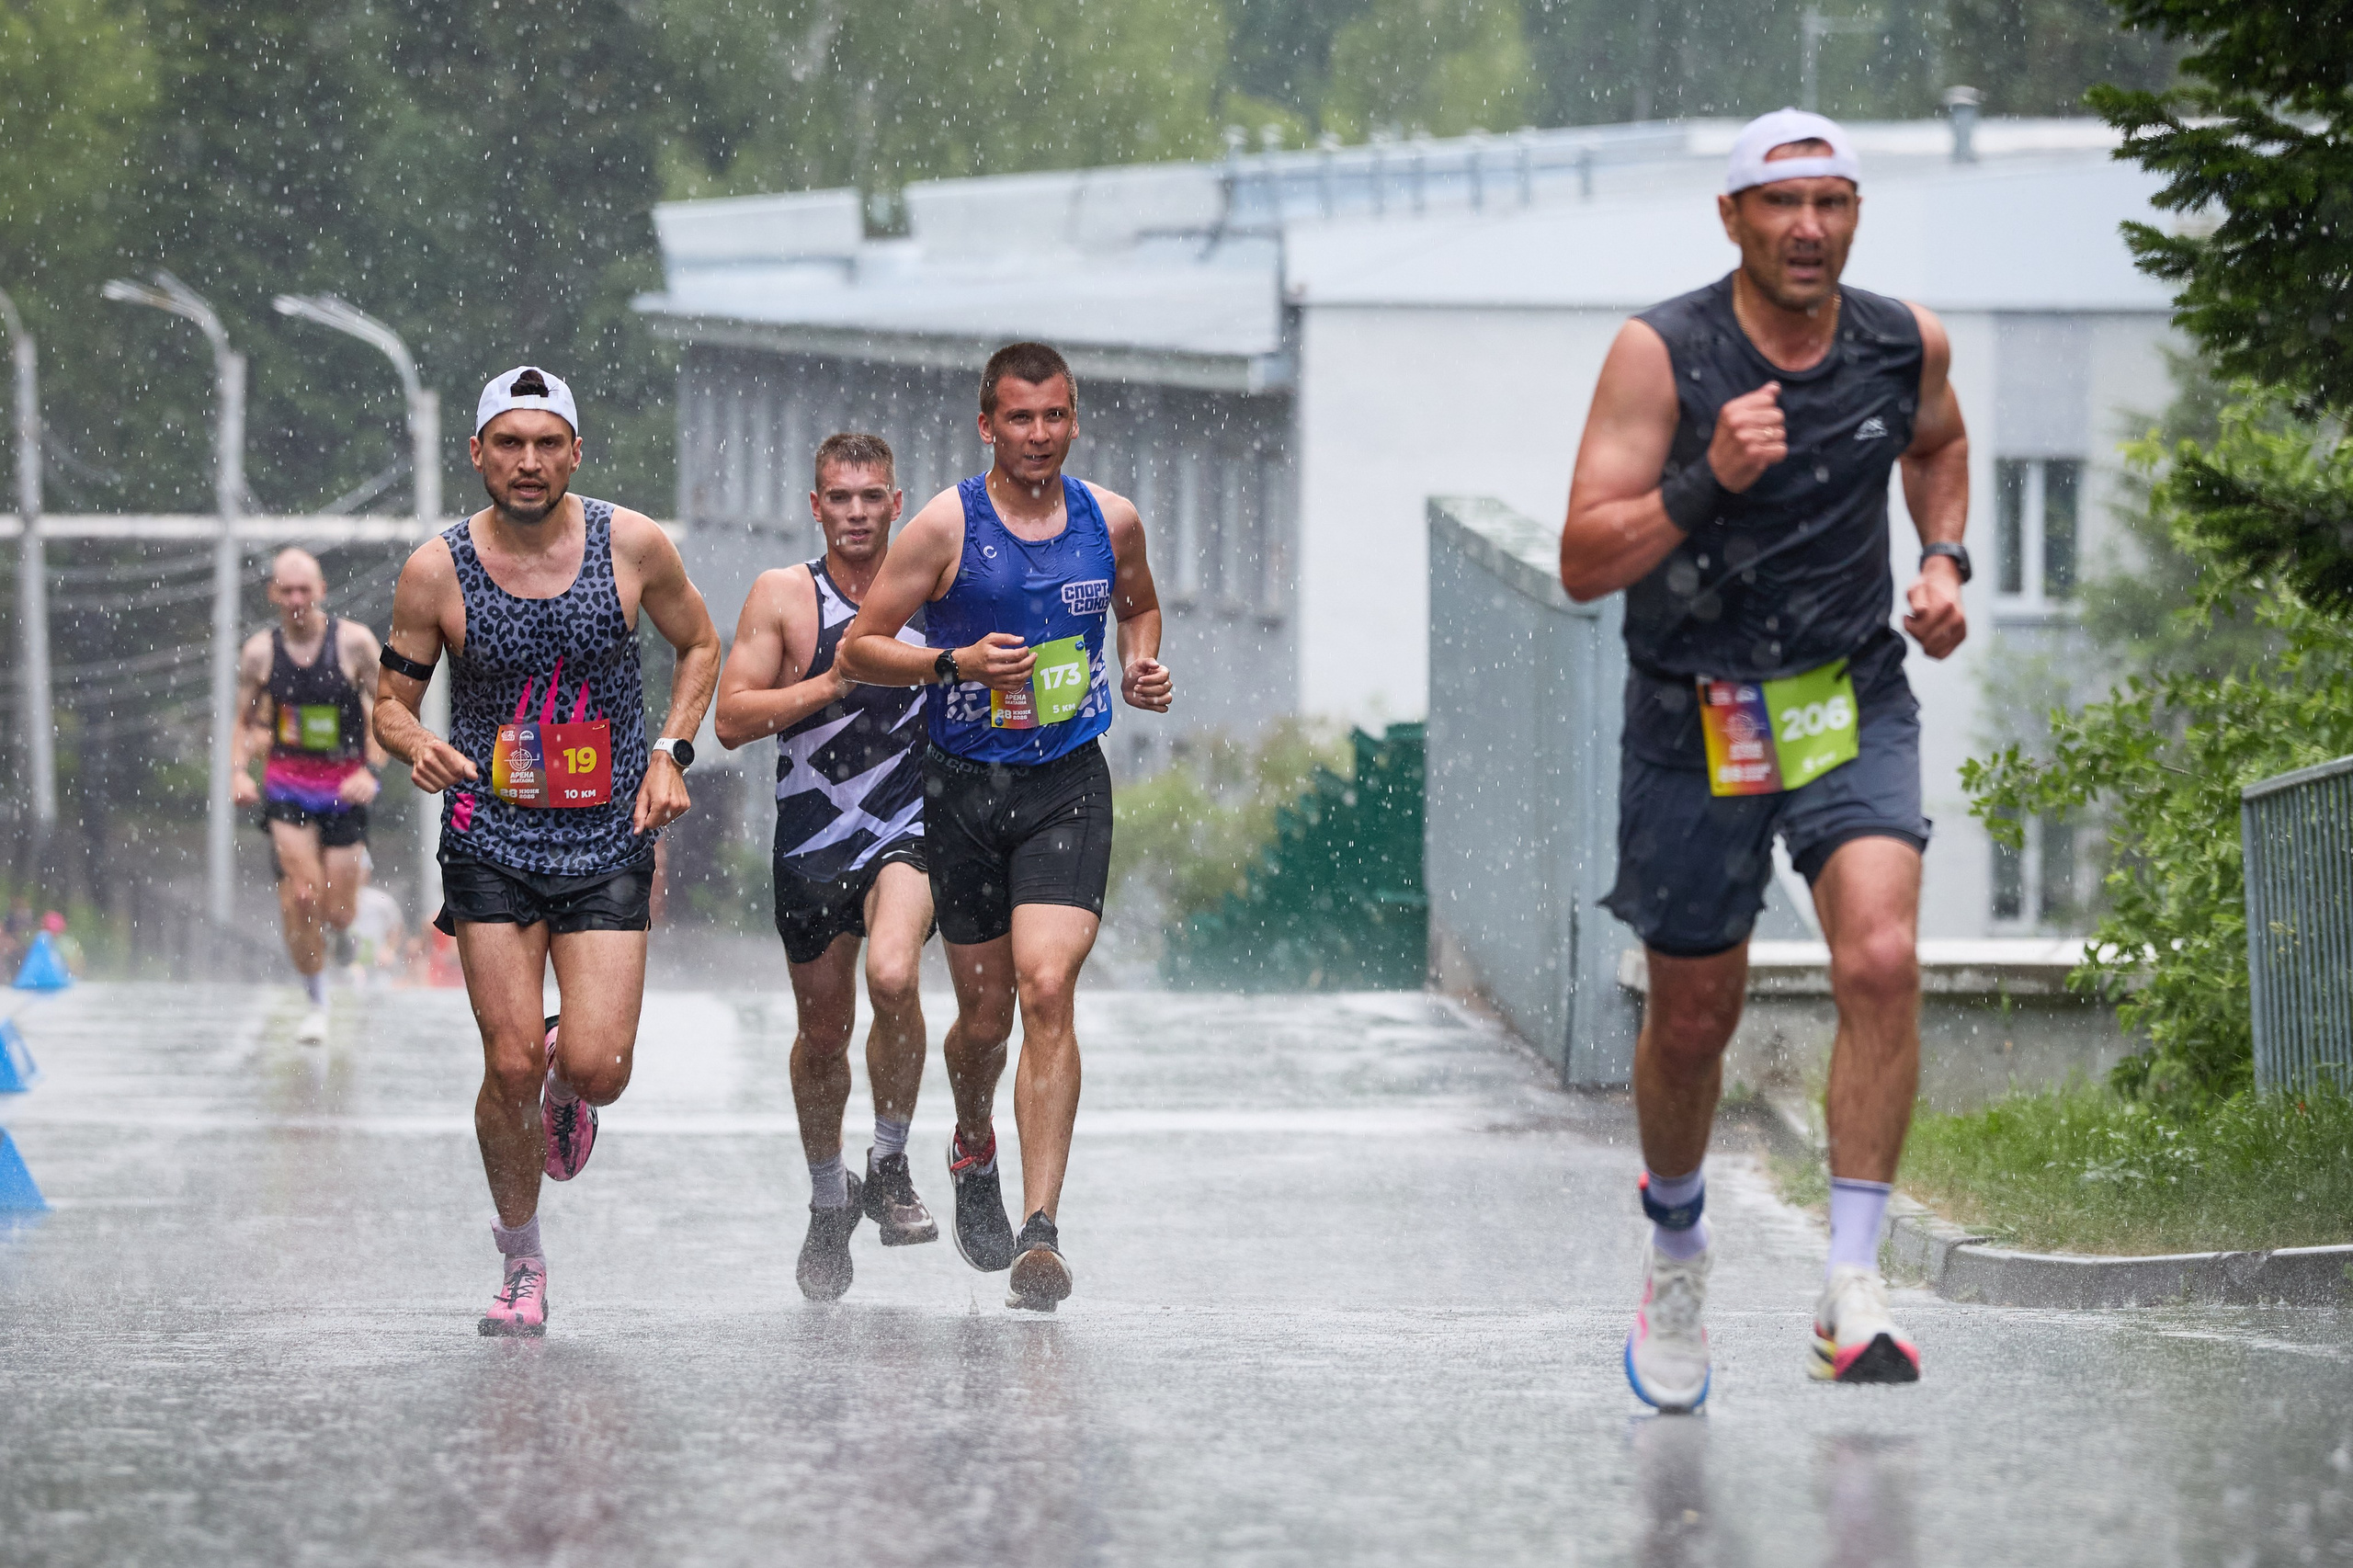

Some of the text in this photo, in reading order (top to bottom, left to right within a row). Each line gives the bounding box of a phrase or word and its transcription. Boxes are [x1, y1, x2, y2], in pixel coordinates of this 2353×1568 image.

[1064, 582, 1108, 600] СПОРТ
[1040, 662, 1081, 690] 173
[996, 709, 1012, 720] 28
[1052, 704, 1060, 713] 5
[1780, 695, 1852, 742] 206
[563, 746, 597, 774] 19
[500, 789, 517, 798] 28
[564, 790, 578, 799] 10
